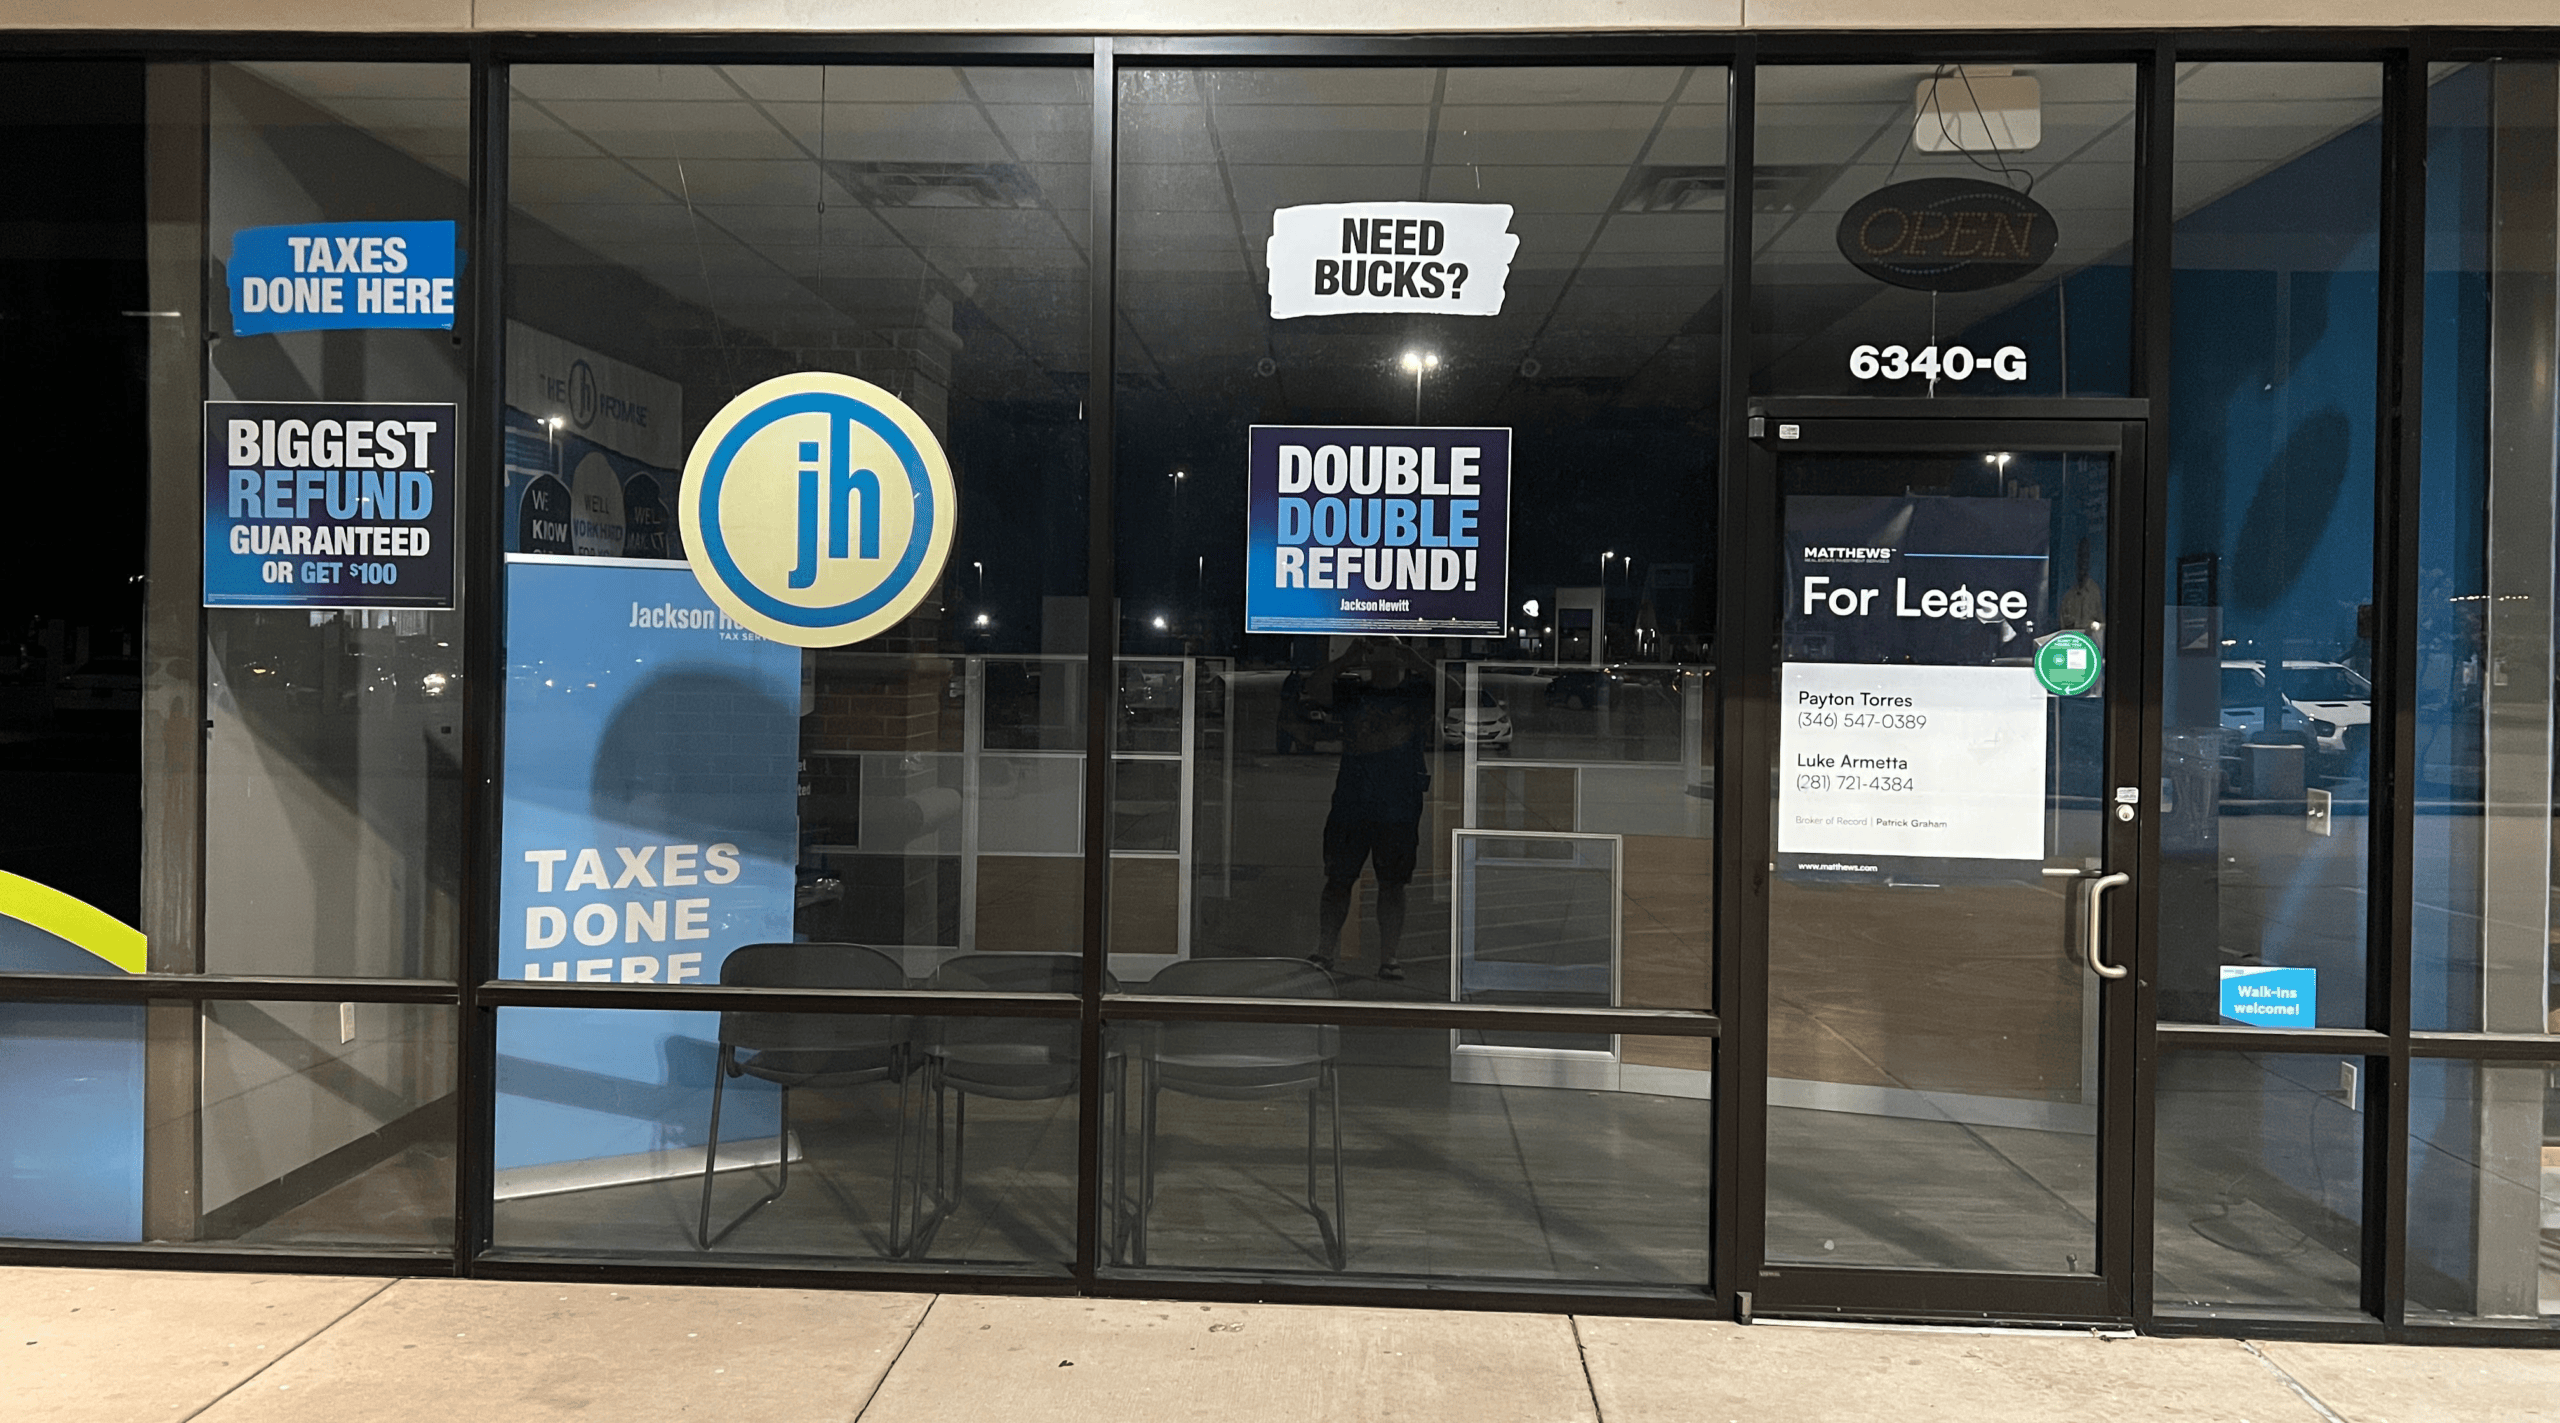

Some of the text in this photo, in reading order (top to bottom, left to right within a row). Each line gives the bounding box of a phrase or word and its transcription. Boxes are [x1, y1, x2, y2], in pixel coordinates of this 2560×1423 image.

[1341, 217, 1445, 257] NEED
[1859, 207, 2038, 258] OPEN
[288, 237, 408, 273] TAXES
[243, 277, 454, 314] DONE HERE
[1314, 259, 1469, 299] BUCKS?
[1849, 345, 2027, 381] 6340-G
[541, 374, 566, 403] HE
[228, 419, 437, 469] BIGGEST
[1278, 445, 1481, 496] DOUBLE
[227, 469, 434, 520] REFUND
[788, 411, 880, 589] jh
[1277, 497, 1480, 547] DOUBLE
[229, 525, 431, 556] GUARANTEED
[262, 561, 397, 585] OR GET $100
[1275, 547, 1478, 592] REFUND!
[629, 602, 715, 629] Jackson
[1340, 598, 1410, 612] Jackson Hewitt
[1804, 576, 2028, 619] For Lease
[719, 633, 739, 641] TAX
[1799, 691, 1913, 709] Payton Torres
[1798, 711, 1927, 729] (346) 547-0389
[1797, 753, 1908, 770] Luke Armetta
[1796, 774, 1914, 792] (281) 721-4384
[1795, 815, 1823, 825] Broker
[1826, 816, 1834, 825] of
[1836, 816, 1868, 826] Record
[1876, 818, 1908, 827] Patrick
[1911, 819, 1948, 828] Graham
[524, 843, 741, 893] TAXES
[1798, 863, 1878, 872] www.matthews.com
[525, 898, 710, 950] DONE
[2233, 1002, 2300, 1015] welcome!
